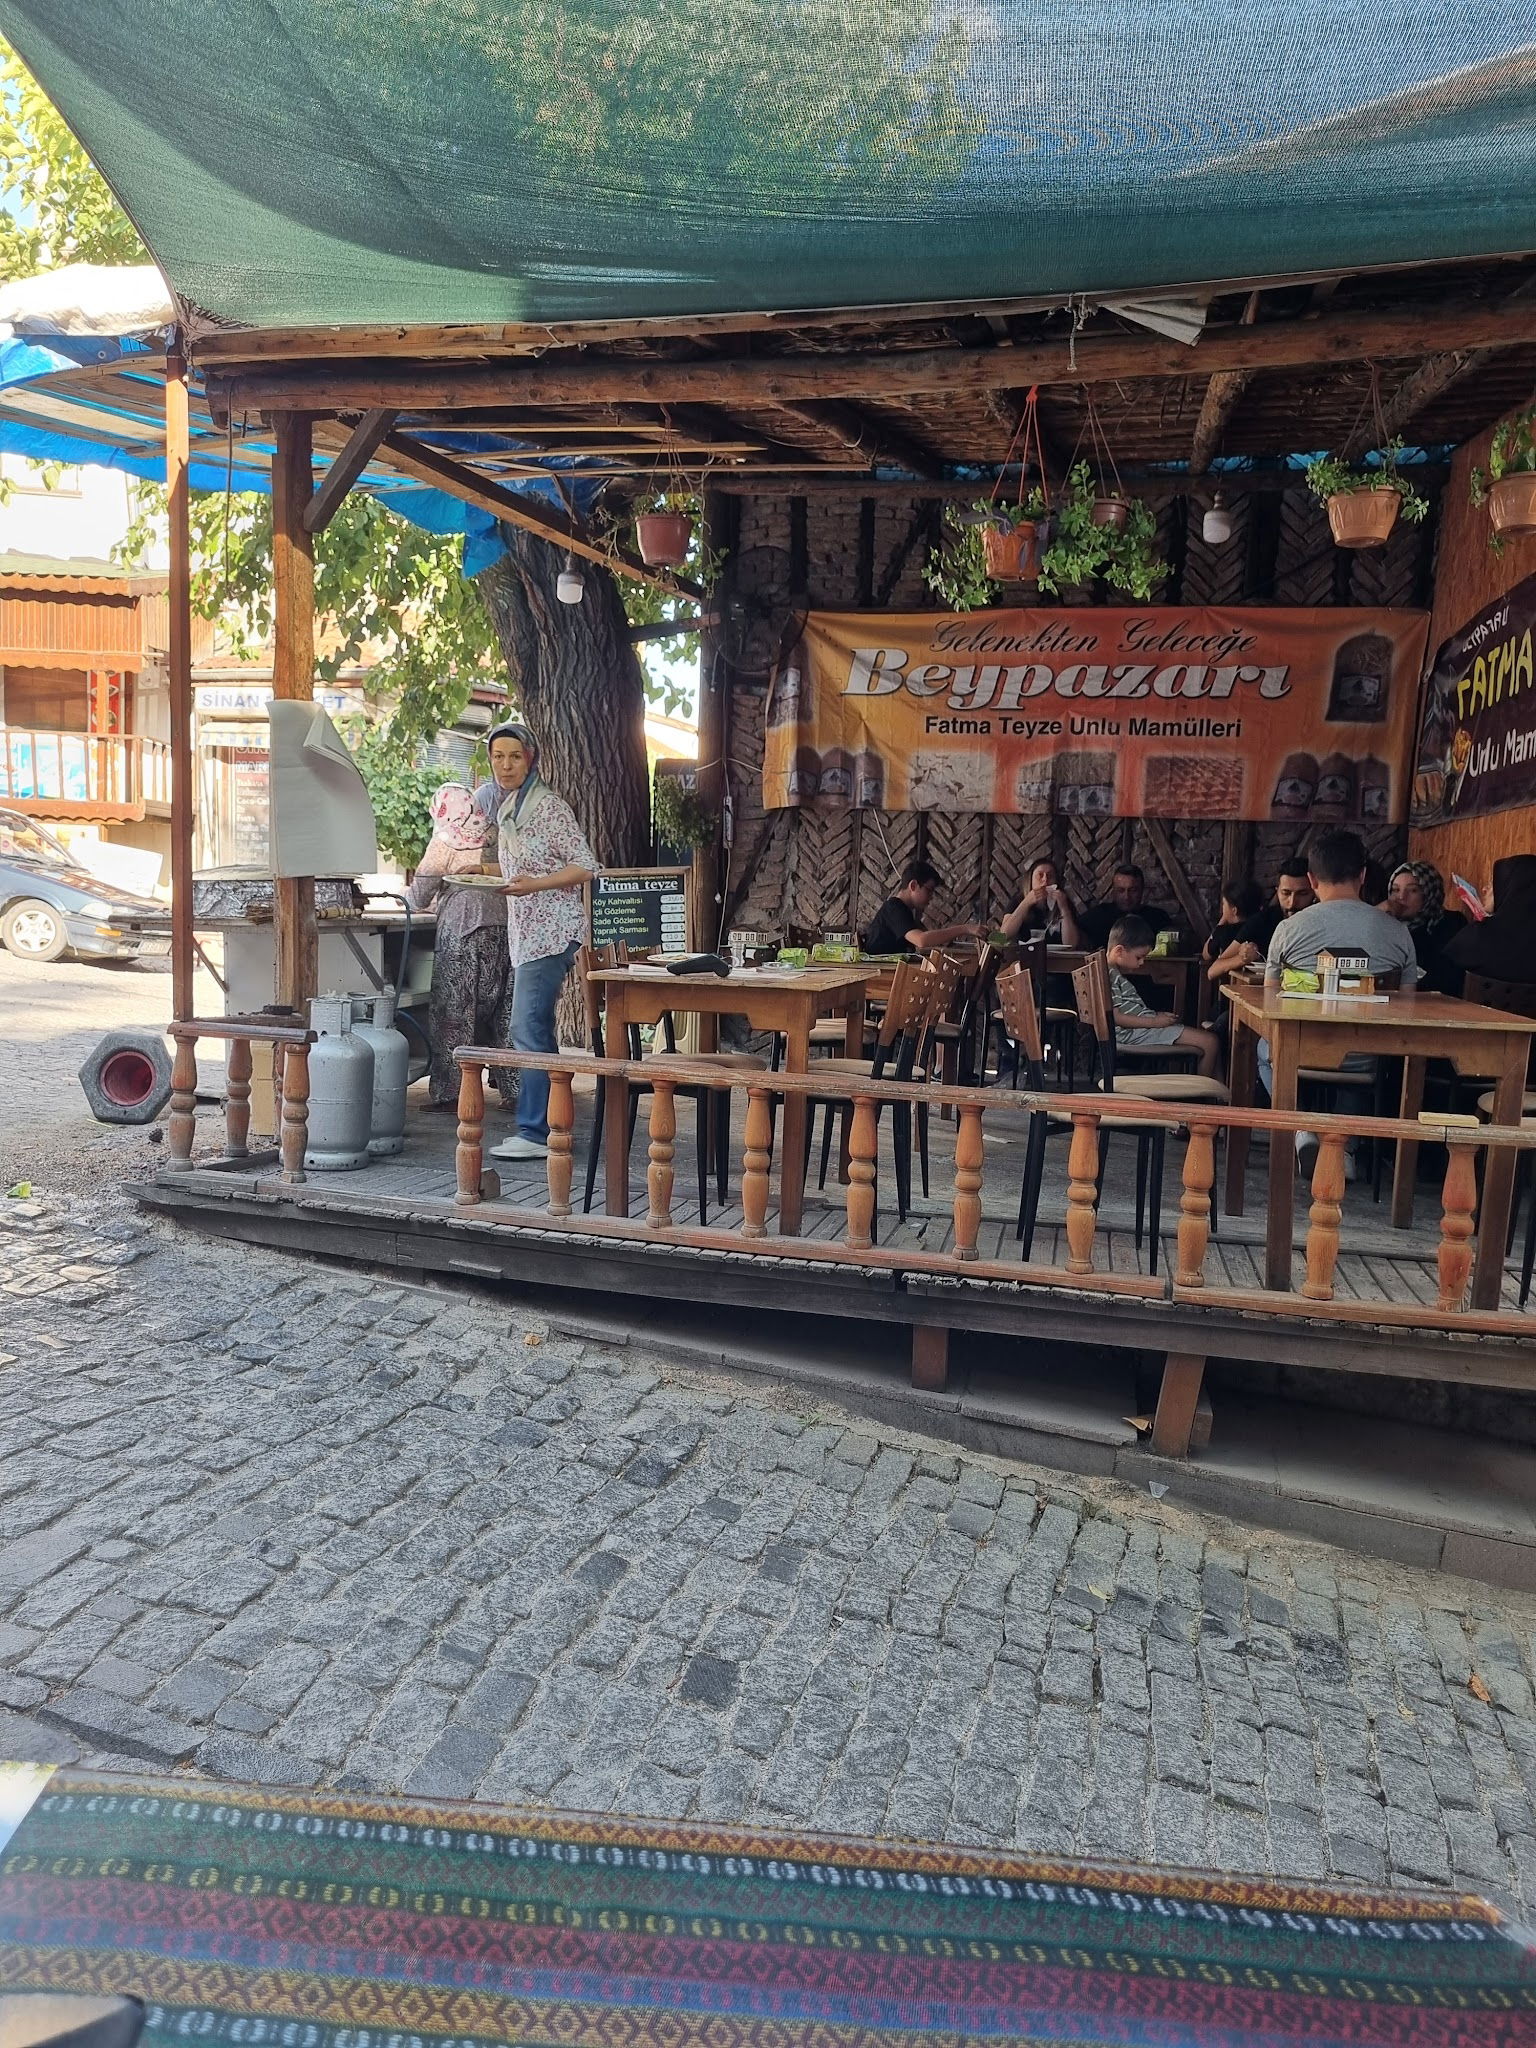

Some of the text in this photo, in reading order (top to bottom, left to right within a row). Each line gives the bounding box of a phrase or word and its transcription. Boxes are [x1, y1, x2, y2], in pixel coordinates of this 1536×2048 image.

[928, 617, 1256, 660] Gelenekten Geleceğe
[841, 648, 1292, 710] Beypazarı
[1457, 627, 1534, 721] FATMA
[202, 691, 260, 708] SİNAN
[925, 715, 1242, 739] Fatma Teyze Unlu Mamülleri
[599, 876, 639, 892] Fatma
[644, 880, 679, 891] teyze
[593, 897, 643, 907] Köy Kahvaltısı
[604, 907, 636, 915] Gözleme
[593, 917, 646, 926] Sade Gözleme
[593, 926, 649, 935] Yaprak Sarması
